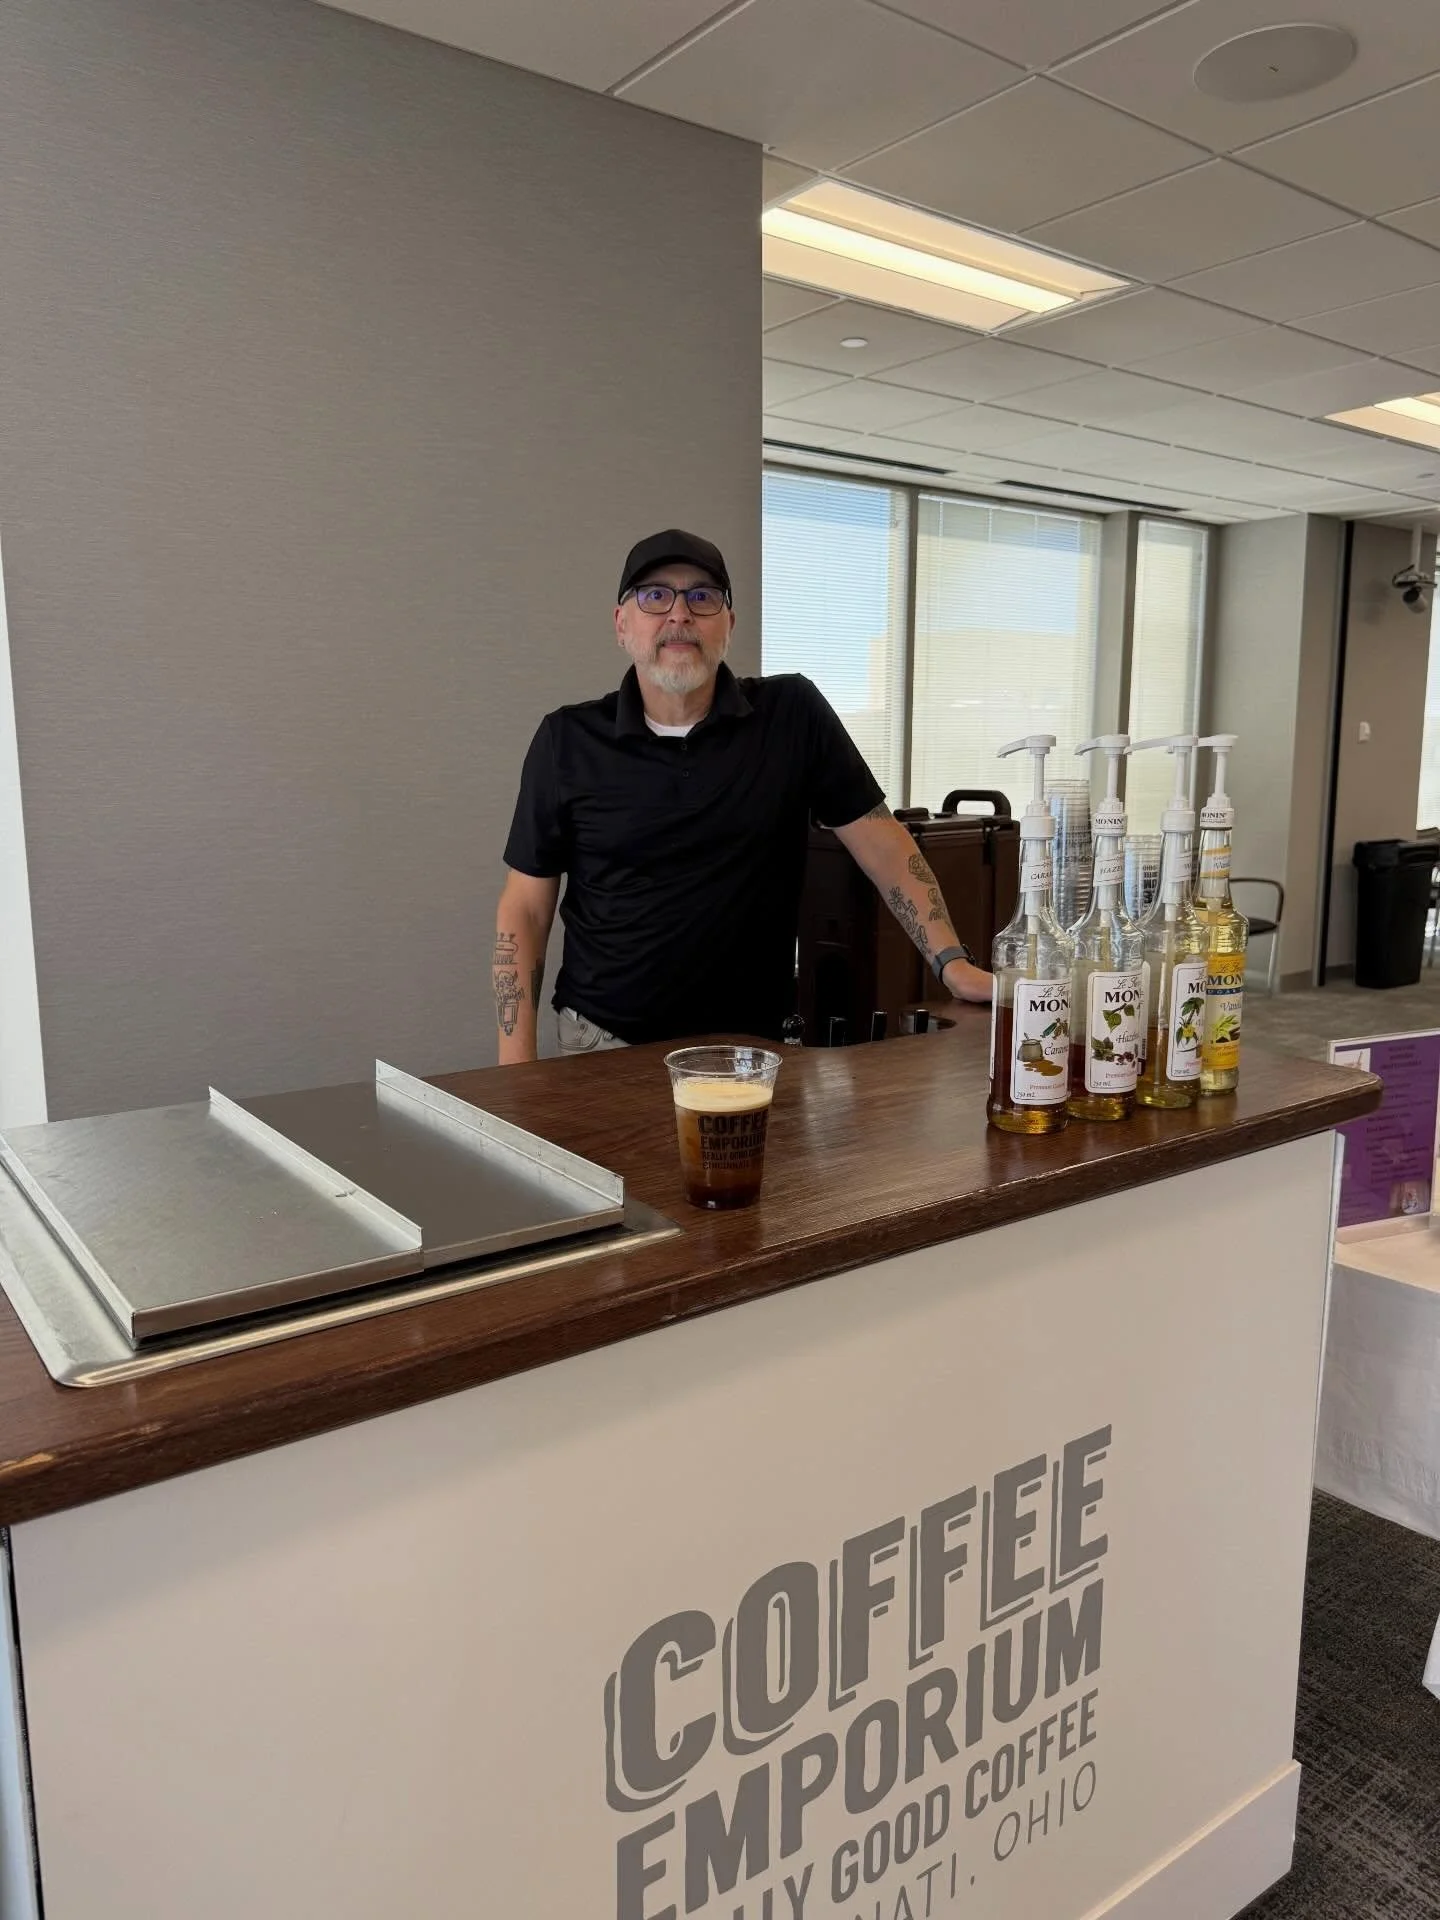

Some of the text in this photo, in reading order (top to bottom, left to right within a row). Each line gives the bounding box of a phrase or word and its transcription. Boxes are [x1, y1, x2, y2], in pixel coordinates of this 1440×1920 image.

[1030, 872, 1051, 880] CARA
[1100, 866, 1122, 875] HAZE
[1207, 974, 1243, 986] MON
[1104, 990, 1140, 1004] MON
[1029, 999, 1070, 1012] MON
[604, 1424, 1112, 1813] COFFEE
[616, 1578, 1104, 1920] EMPORIUM
[831, 1783, 951, 1904] GOOD
[964, 1687, 1098, 1820] COFFEE
[993, 1760, 1097, 1862] OHIO
